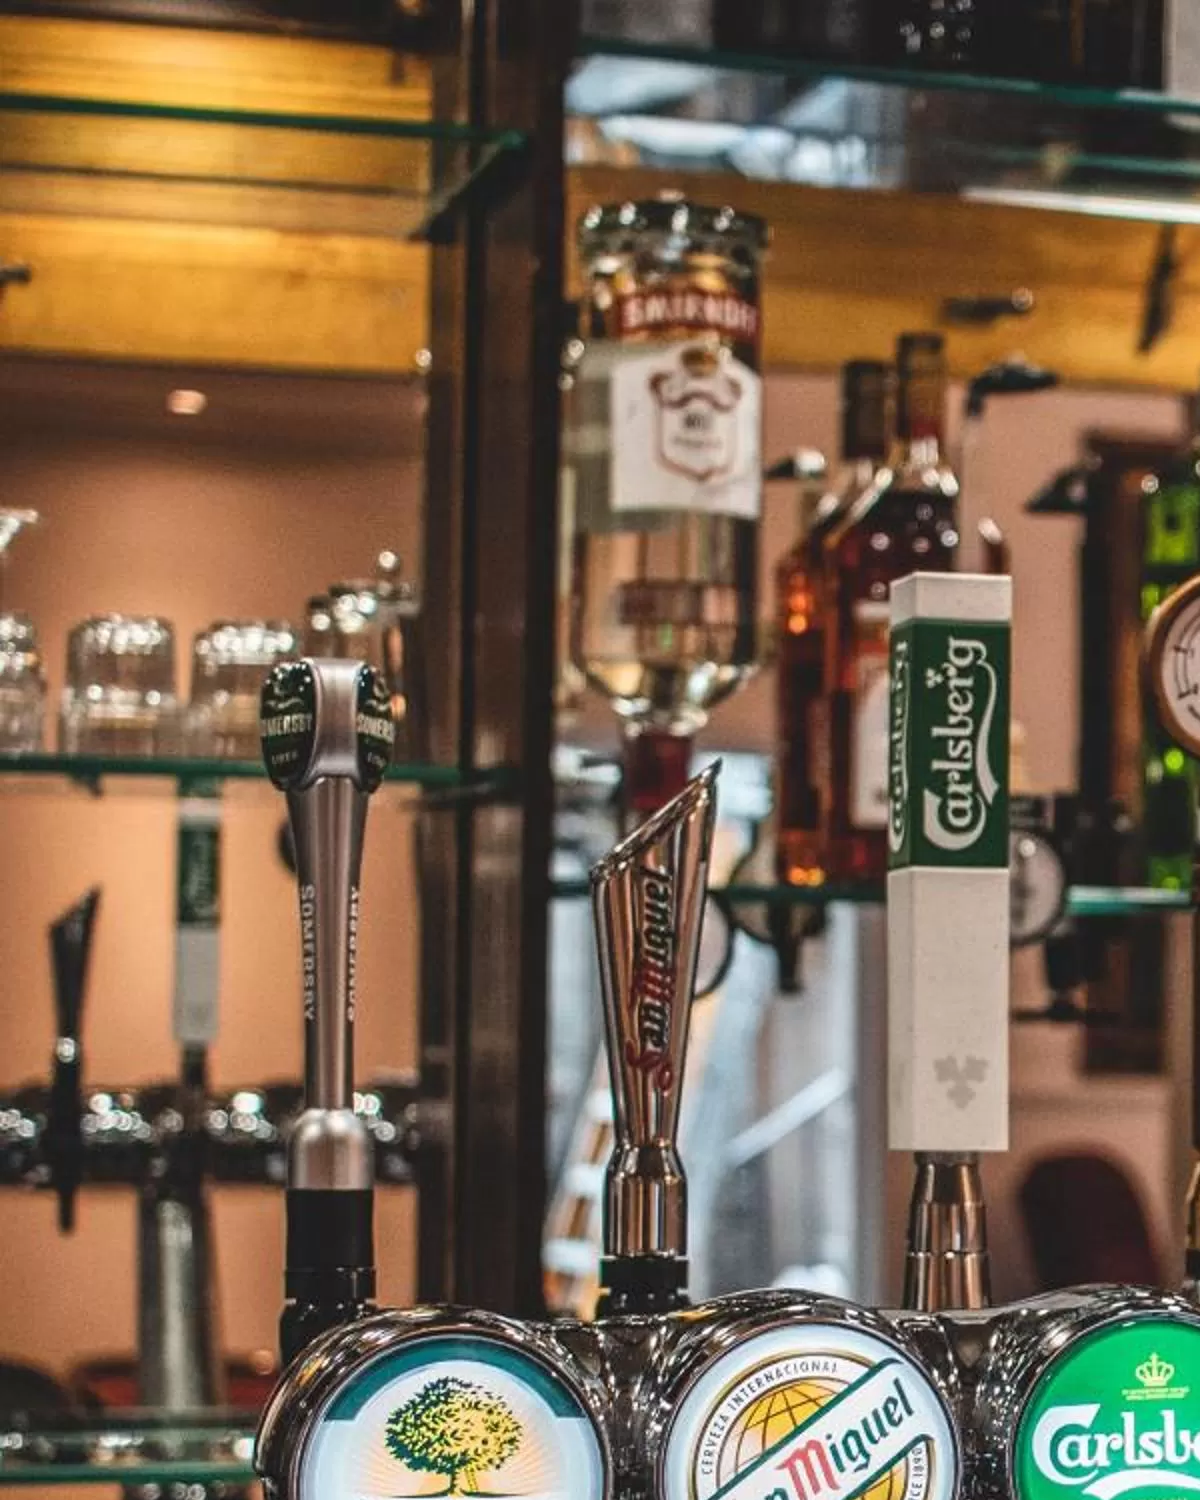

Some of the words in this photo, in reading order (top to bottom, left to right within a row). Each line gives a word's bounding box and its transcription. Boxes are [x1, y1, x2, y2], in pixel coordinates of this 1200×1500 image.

[923, 636, 998, 850] Carlsberg
[701, 1413, 729, 1475] CERVEZA
[727, 1361, 838, 1411] INTERNACIONAL
[911, 1448, 924, 1477] 1890
